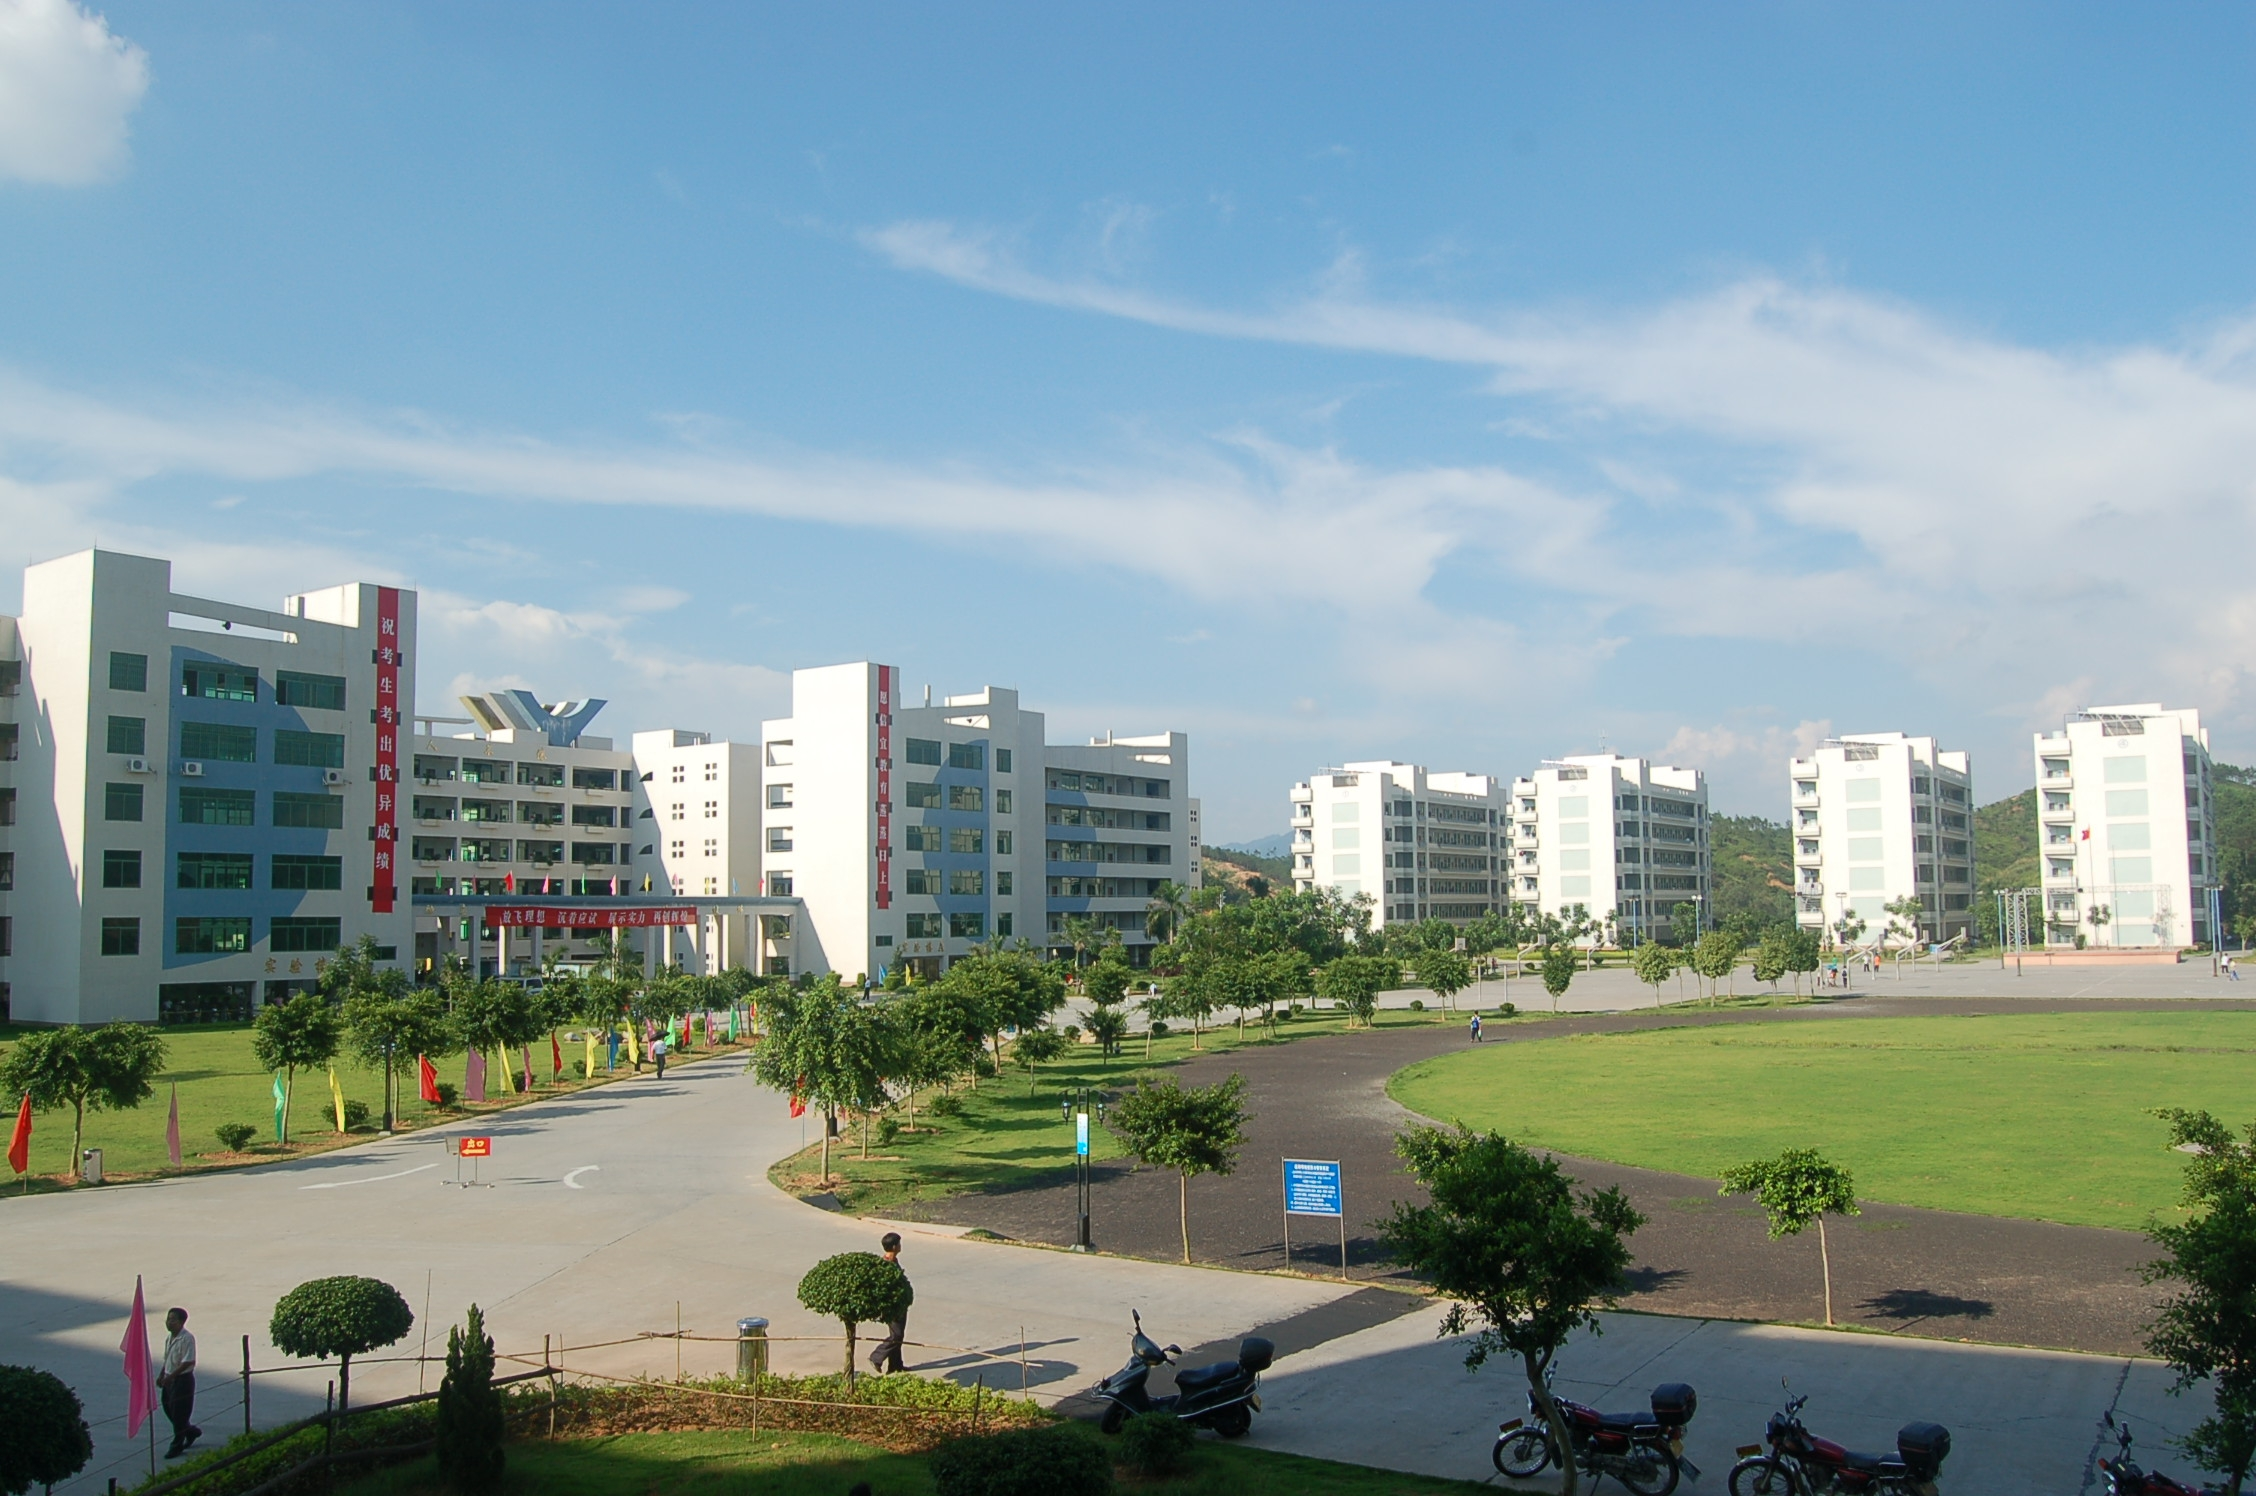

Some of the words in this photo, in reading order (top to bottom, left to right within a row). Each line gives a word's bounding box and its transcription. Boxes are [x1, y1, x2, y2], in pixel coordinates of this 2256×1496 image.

[375, 616, 395, 870] 祝考生考出优异成绩
[879, 691, 888, 885] 愿信宜教育蒸蒸日上
[502, 910, 546, 924] 放飞理想
[557, 911, 598, 925] 沉着应试
[608, 911, 646, 925] 展示实力
[653, 910, 688, 923] 再创辉煌
[467, 1138, 485, 1149] 出口
